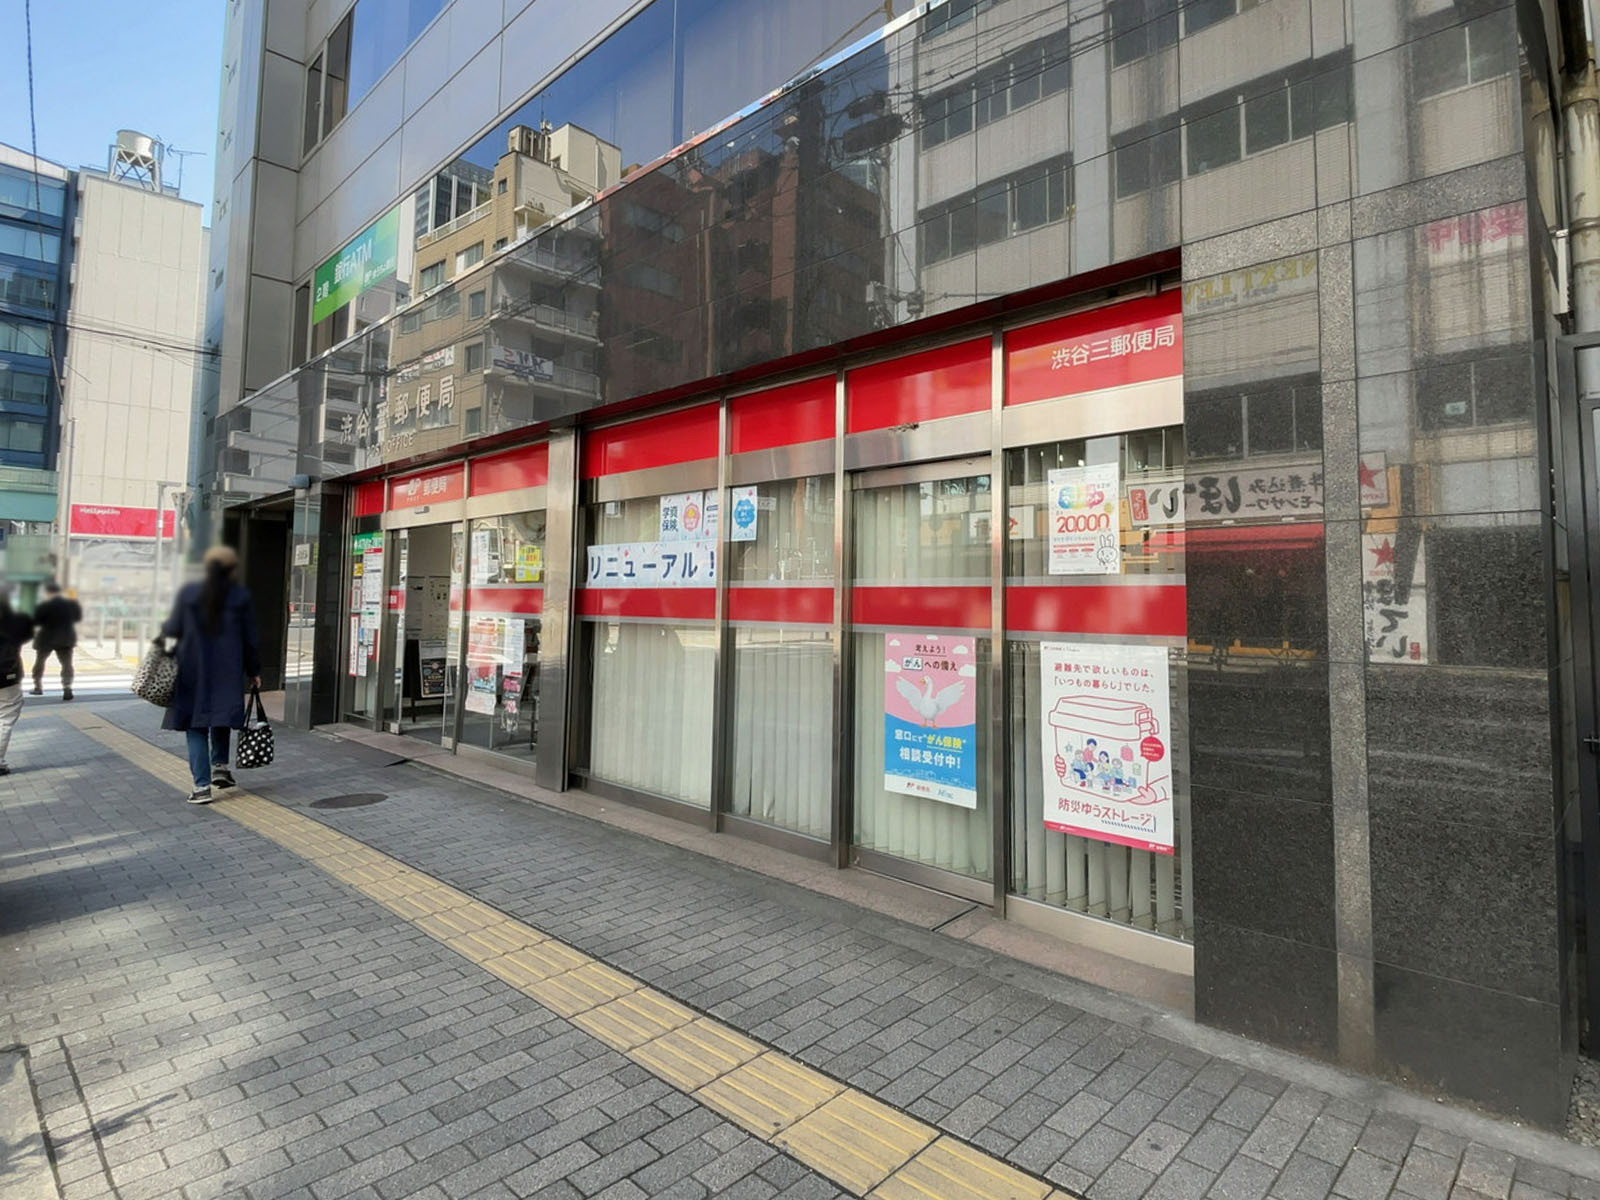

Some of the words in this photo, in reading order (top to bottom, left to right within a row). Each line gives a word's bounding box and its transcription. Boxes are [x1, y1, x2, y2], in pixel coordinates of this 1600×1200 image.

[1051, 325, 1175, 370] 渋谷三郵便局
[662, 519, 679, 532] 保険
[915, 644, 946, 655] 考えよう!
[1054, 662, 1154, 678] 避難先で欲しいものは、
[900, 747, 961, 769] 相談受付中!
[1058, 797, 1153, 827] 防災ゆうストレージ
